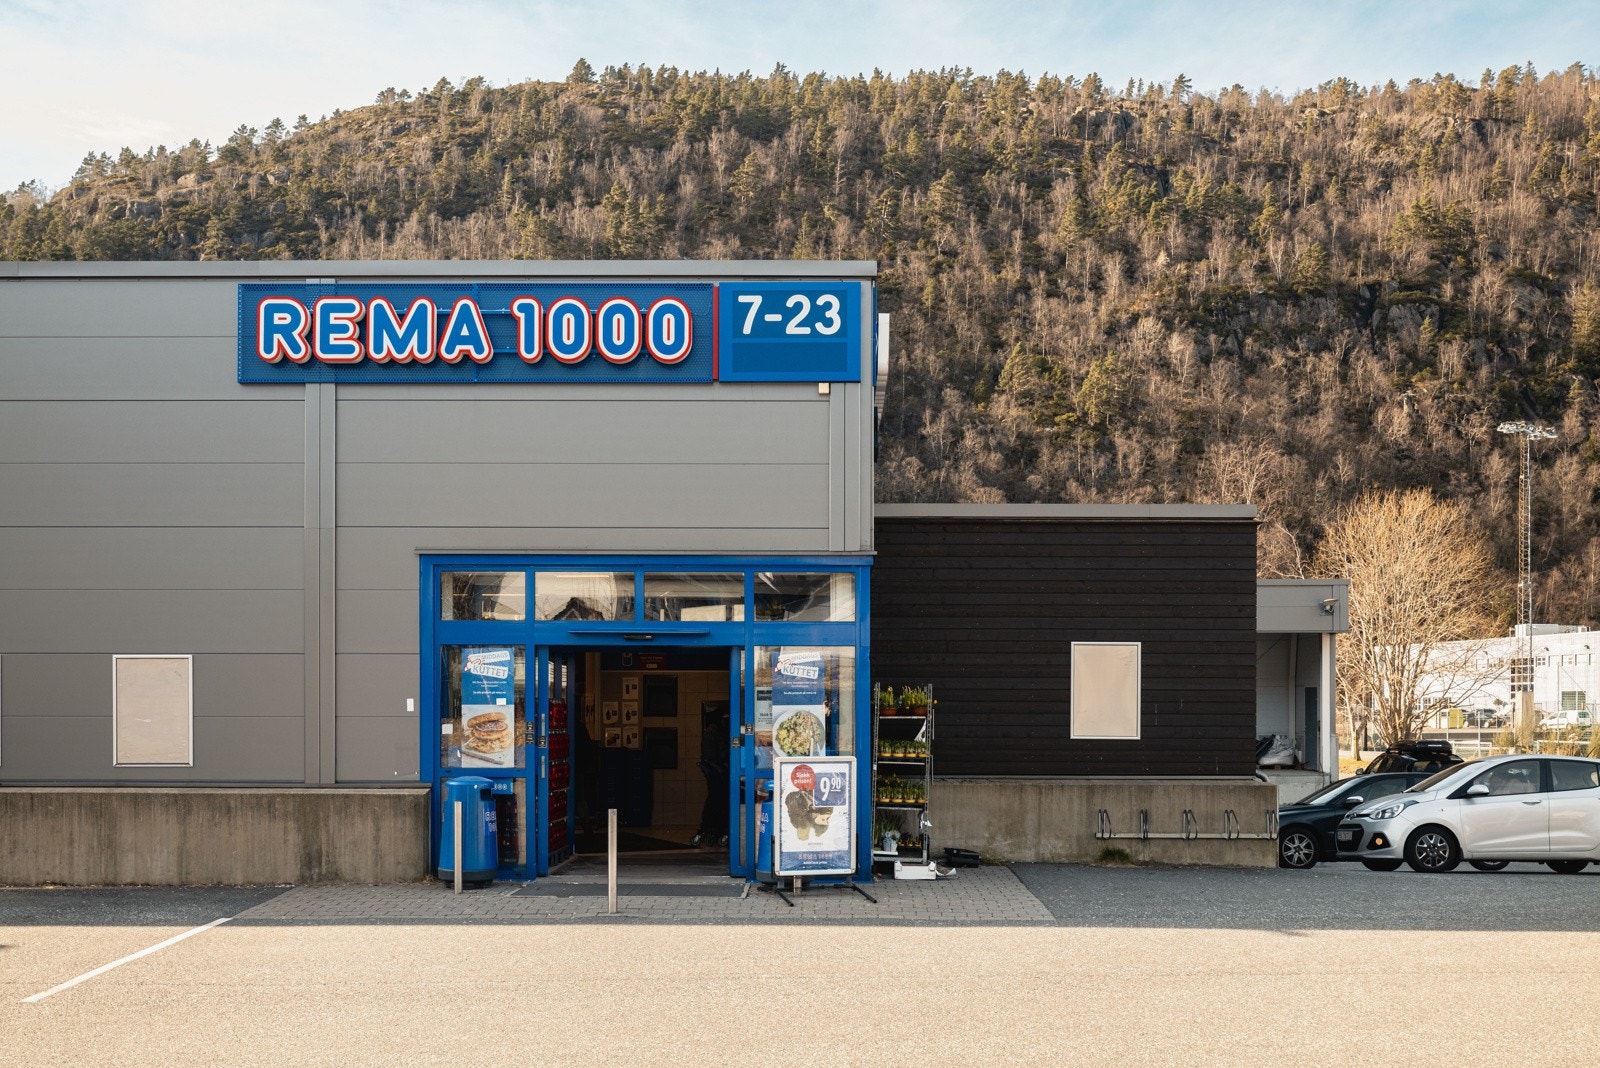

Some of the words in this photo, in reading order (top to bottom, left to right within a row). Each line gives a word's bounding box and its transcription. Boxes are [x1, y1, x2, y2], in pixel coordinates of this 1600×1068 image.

[736, 293, 842, 337] 7-23
[256, 296, 494, 365] REMA
[511, 295, 694, 364] 1000
[472, 664, 508, 678] KUTTET
[782, 665, 818, 678] KUTTET
[819, 776, 831, 802] 9
